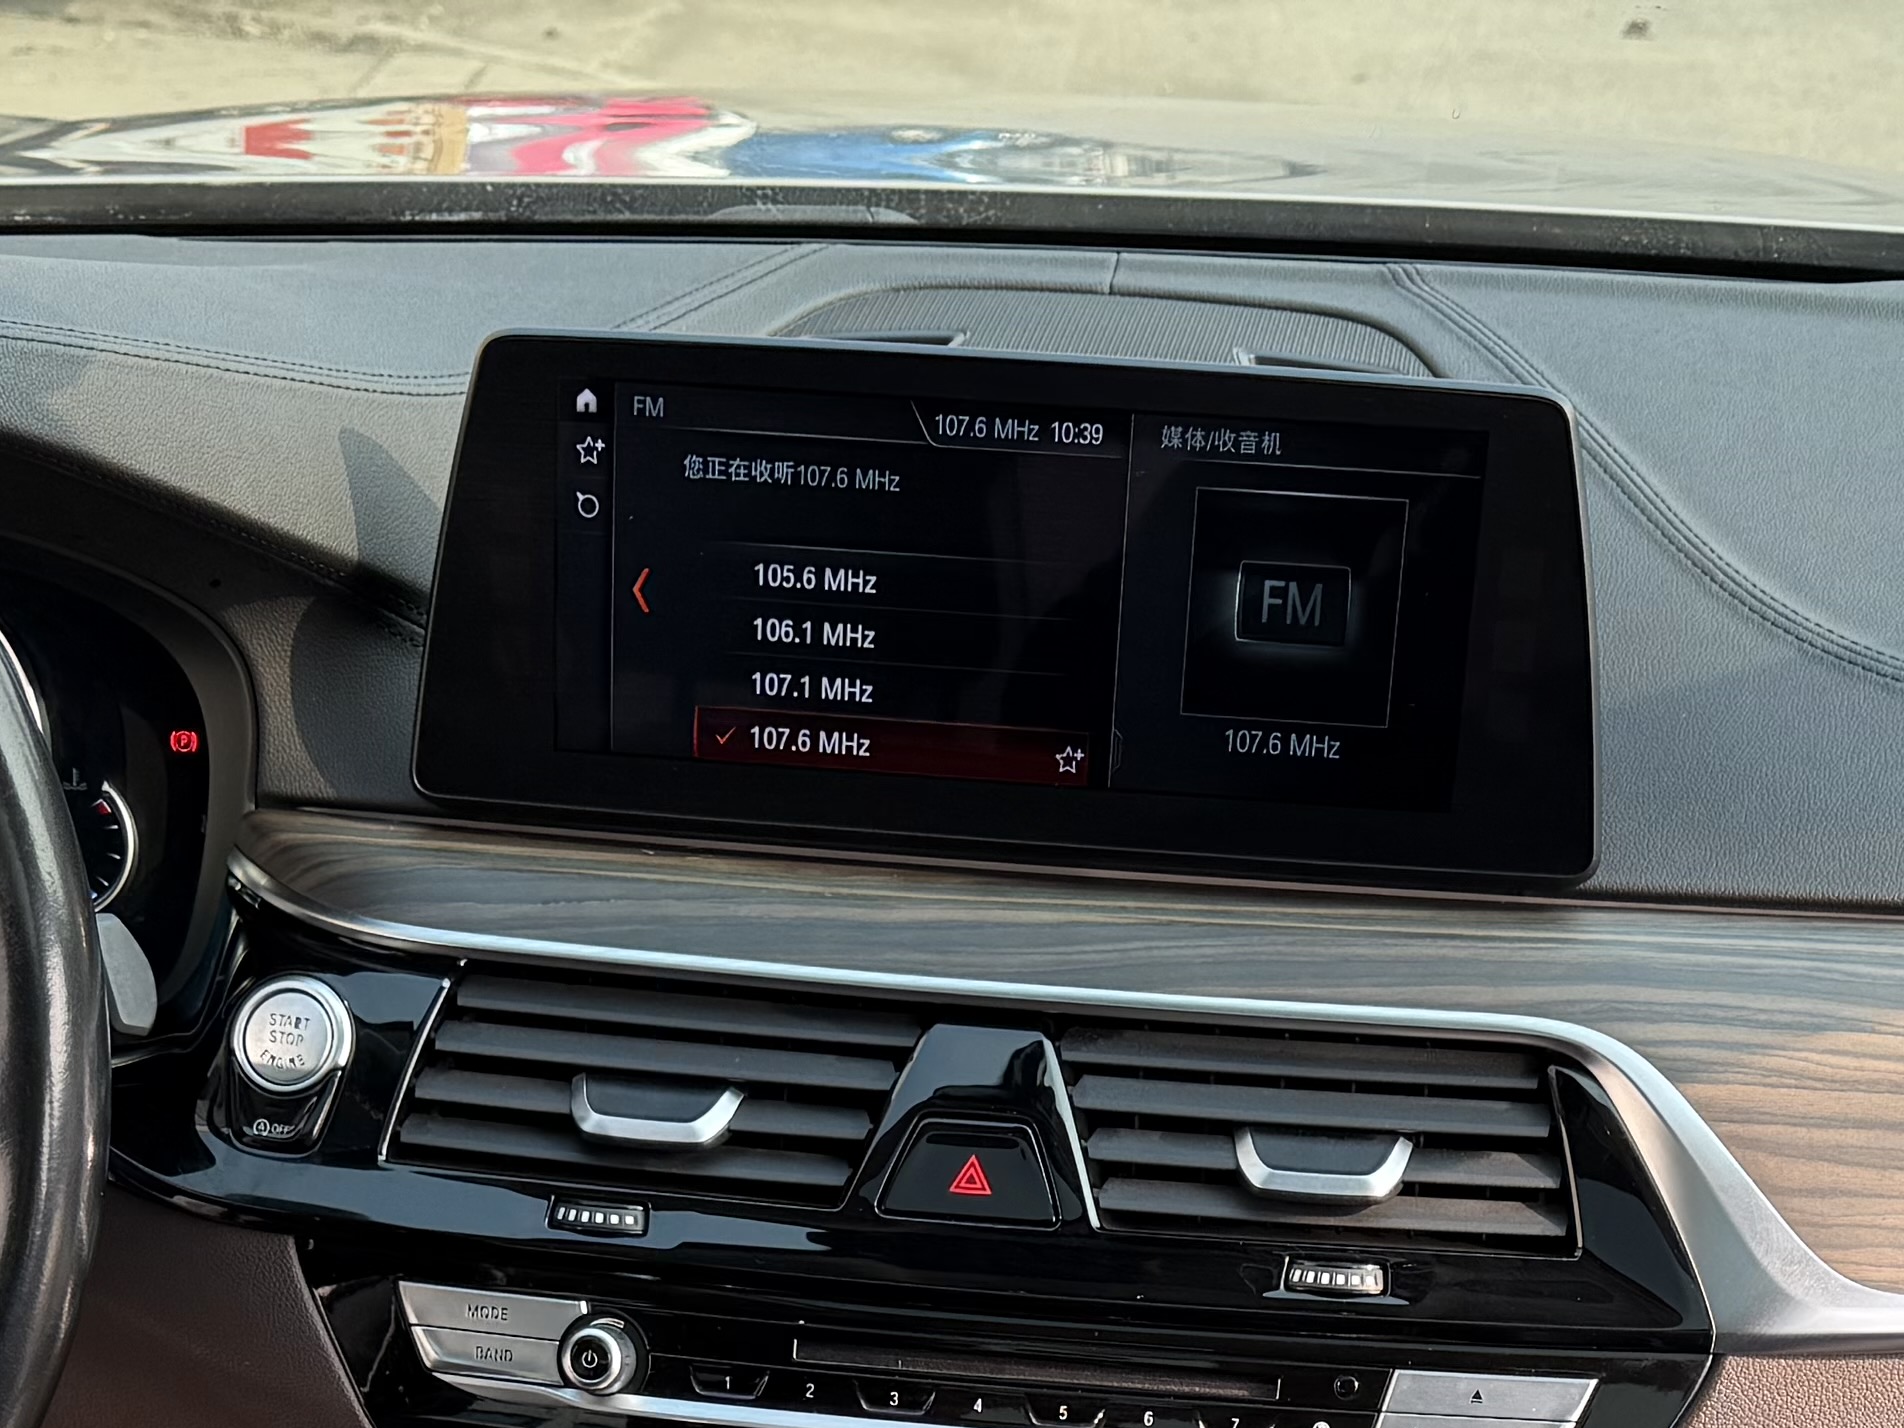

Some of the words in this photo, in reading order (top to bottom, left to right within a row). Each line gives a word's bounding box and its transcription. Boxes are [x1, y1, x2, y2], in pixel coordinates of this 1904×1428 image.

[633, 396, 664, 418] FM
[935, 414, 987, 438] 107.6
[994, 418, 1040, 442] MHz
[1050, 421, 1104, 446] 10:39
[1160, 425, 1282, 455] 媒体/收音机
[854, 468, 901, 492] MHz
[753, 562, 816, 590] 105.6
[823, 566, 877, 594] MHz
[1261, 579, 1324, 627] FM
[752, 616, 812, 645] 106.1
[822, 621, 876, 648] MHz
[751, 671, 810, 699] 107.1
[820, 676, 874, 703] MHz
[749, 724, 811, 752] 107.6
[818, 729, 871, 757] MHz
[1224, 728, 1282, 755] 107.6
[1289, 733, 1341, 759] MHz
[269, 1012, 311, 1031] START
[269, 1029, 304, 1047] STOP
[259, 1048, 306, 1070] ENGINE
[465, 1303, 509, 1323] MODE
[474, 1345, 514, 1364] BAND
[724, 1375, 732, 1389] 1
[805, 1383, 815, 1398] 2
[889, 1391, 900, 1406] 3
[972, 1397, 983, 1413] 4
[1058, 1404, 1068, 1421] 5
[1143, 1410, 1154, 1427] 6
